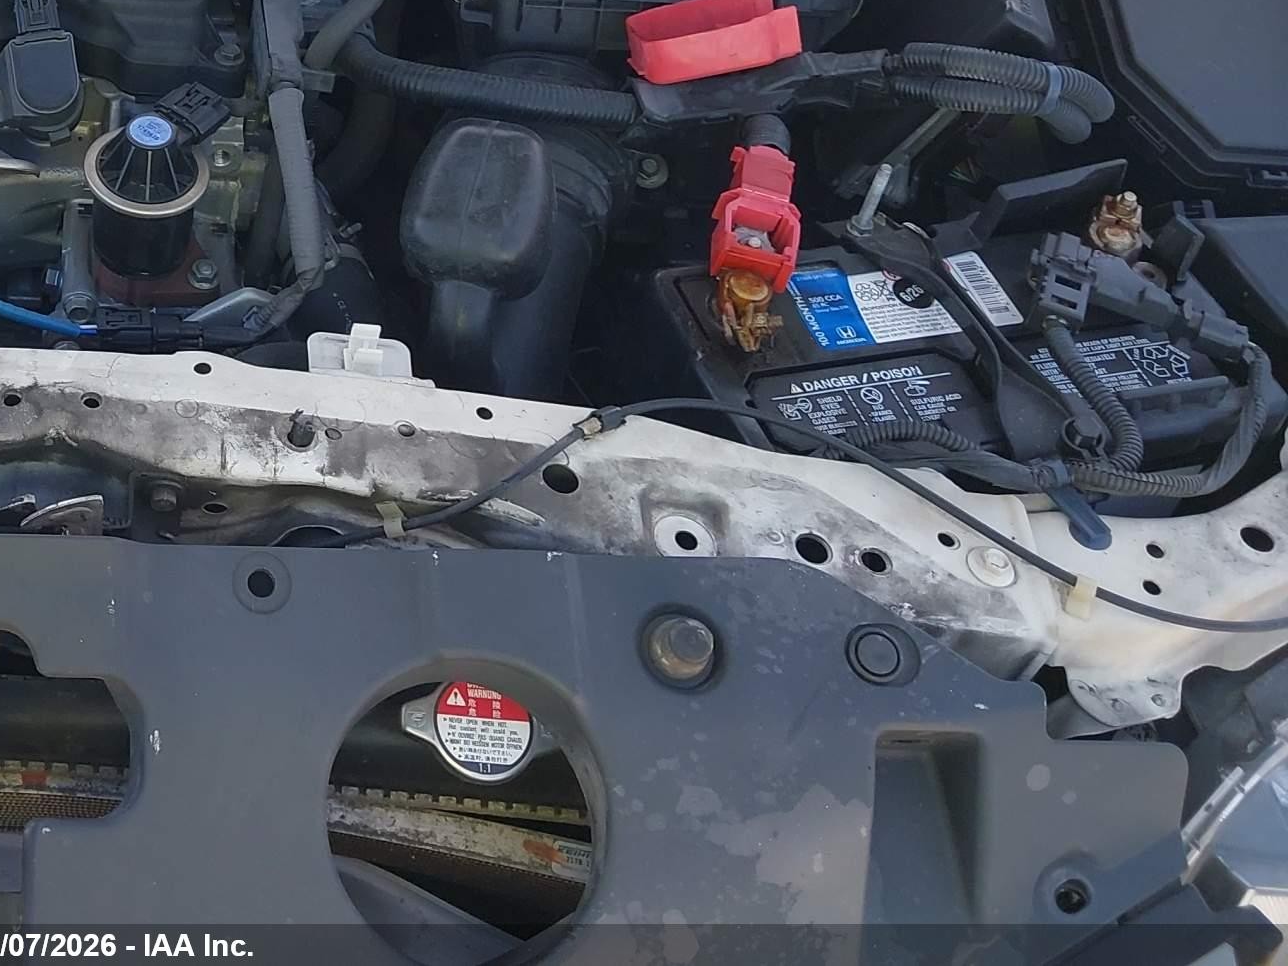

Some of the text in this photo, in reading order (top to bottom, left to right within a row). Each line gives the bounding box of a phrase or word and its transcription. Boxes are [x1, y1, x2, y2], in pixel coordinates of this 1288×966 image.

[793, 296, 821, 331] MONTH
[815, 331, 831, 347] 100
[836, 337, 867, 345] HONDA
[802, 375, 861, 392] DANGER
[870, 366, 923, 382] POISON
[816, 395, 842, 404] SHIELD
[910, 393, 962, 406] SULFURIC ACID
[820, 402, 840, 410] EYES
[808, 408, 848, 419] EXPLOSIVE
[479, 762, 491, 774] 1.1
